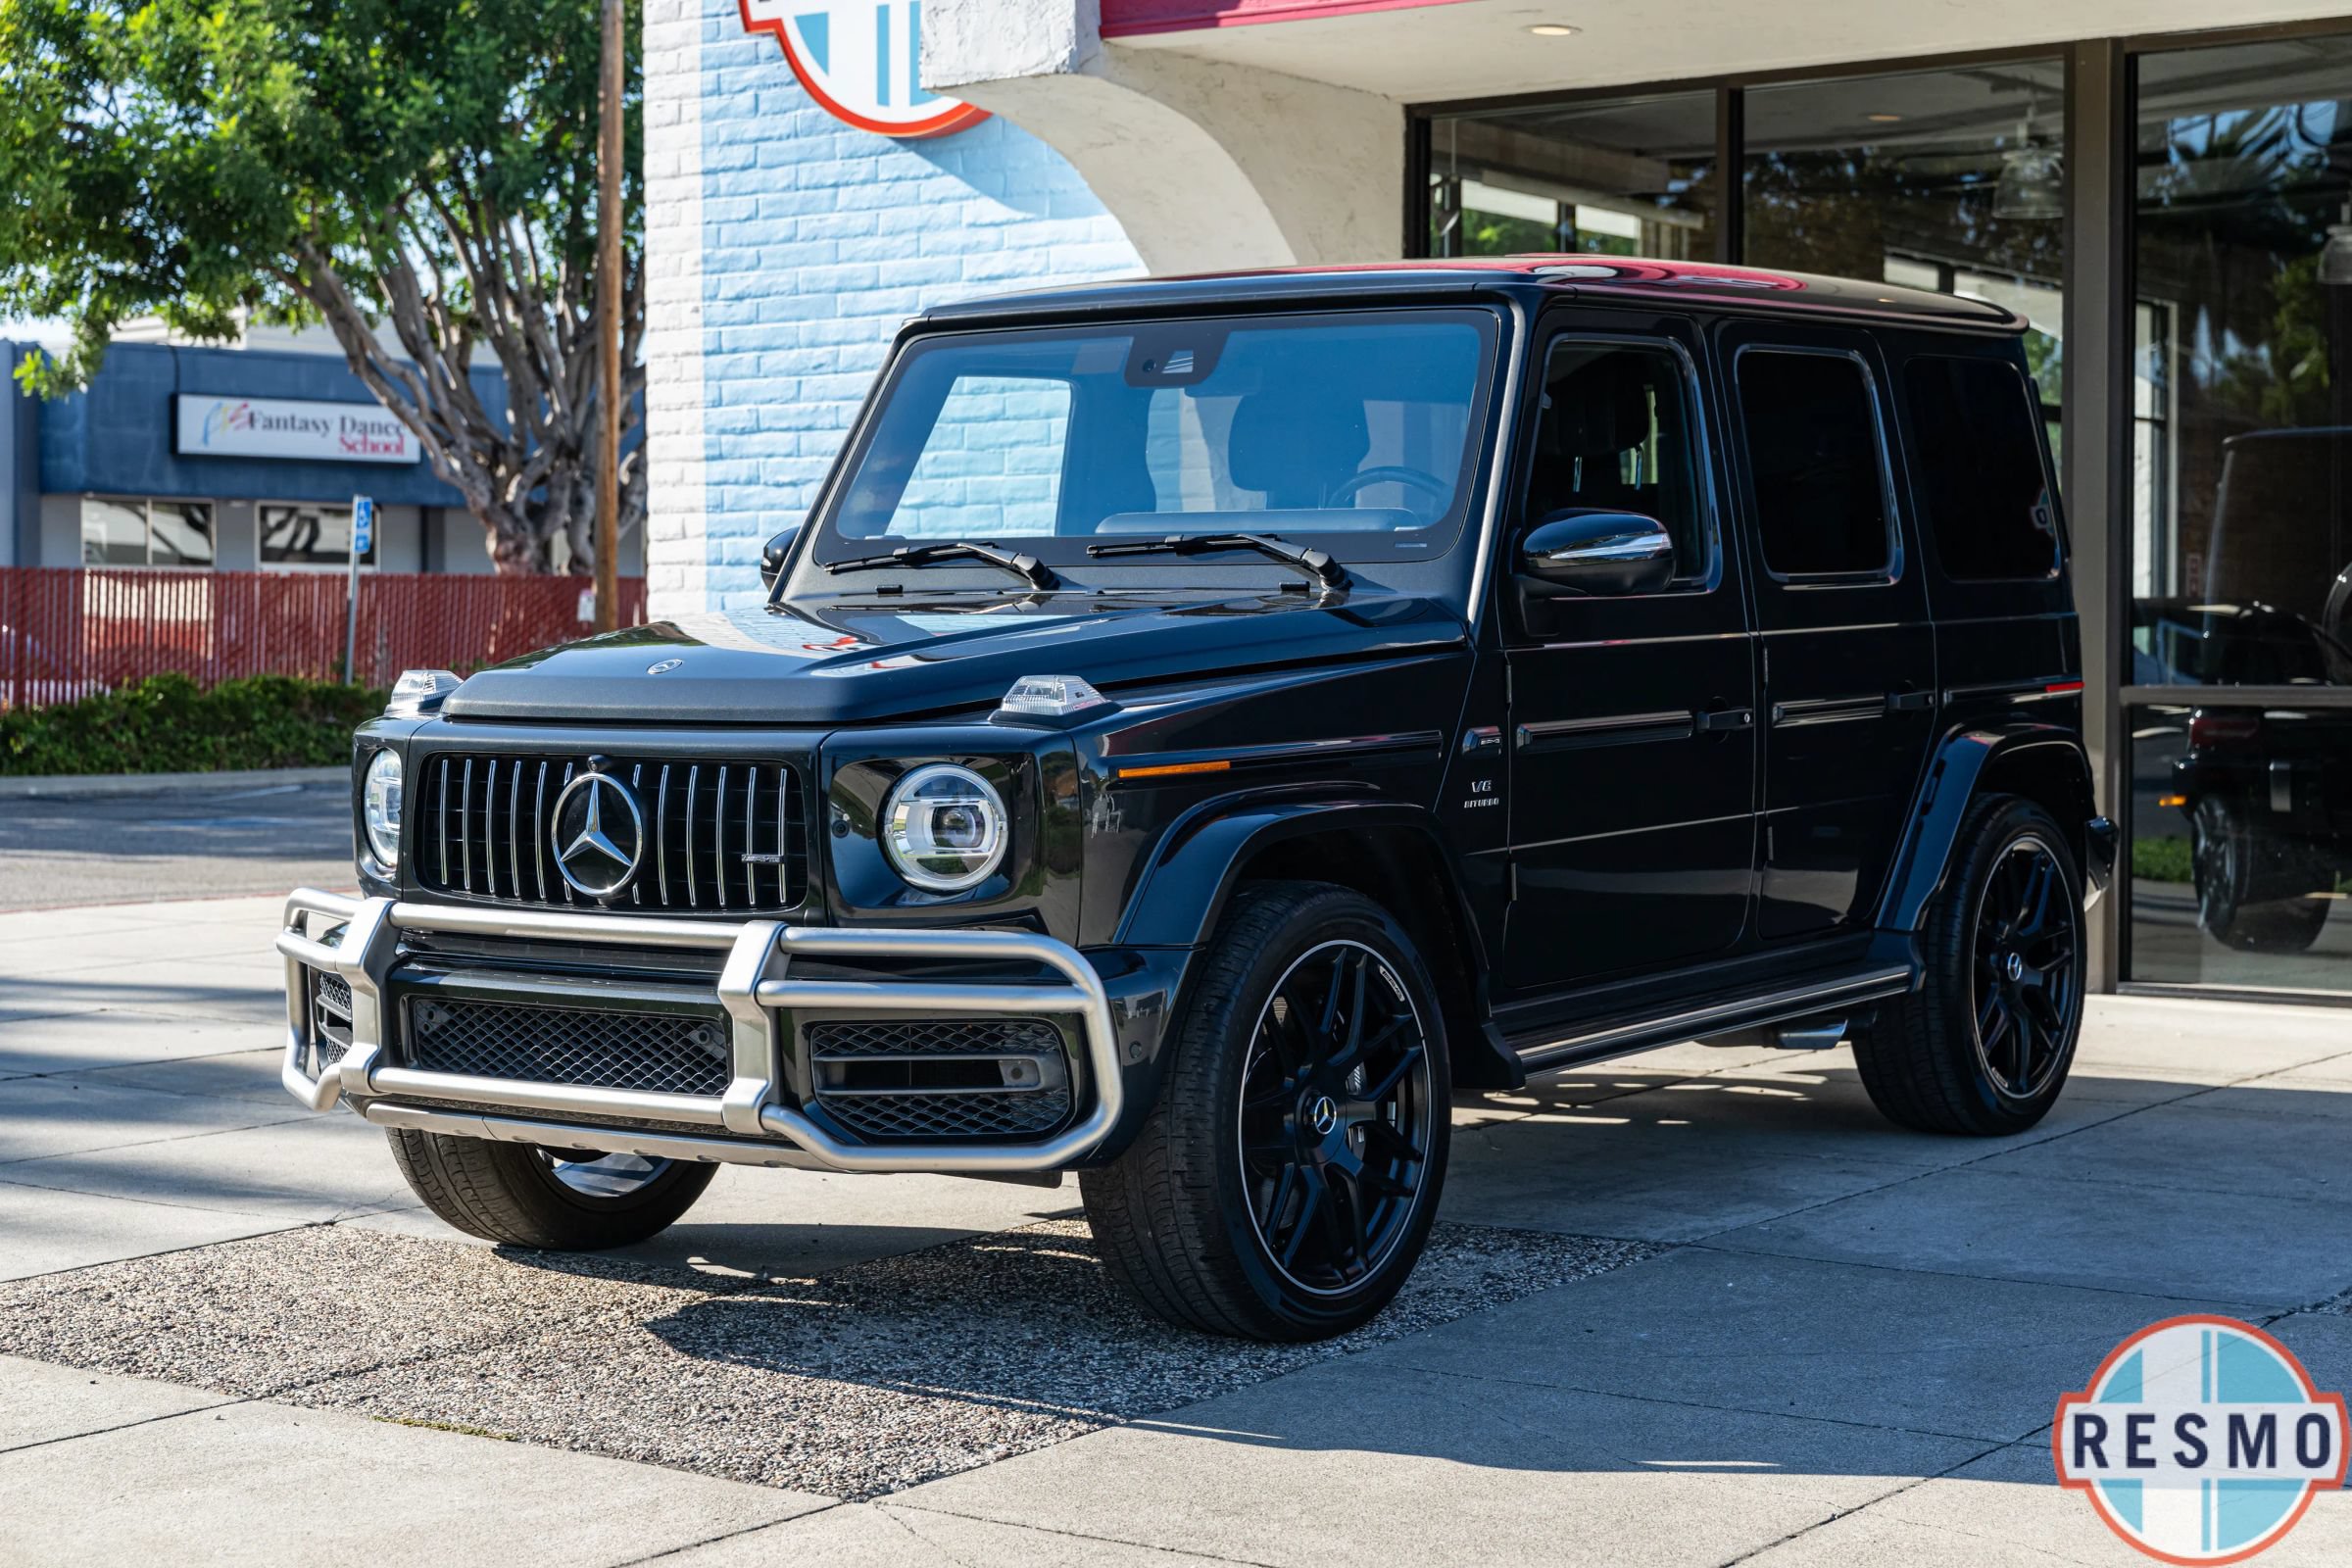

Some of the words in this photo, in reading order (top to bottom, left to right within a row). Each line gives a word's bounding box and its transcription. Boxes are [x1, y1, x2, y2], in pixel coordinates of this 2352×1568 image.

[248, 411, 332, 437] Fantasy
[339, 415, 404, 436] Dance
[339, 434, 404, 455] School
